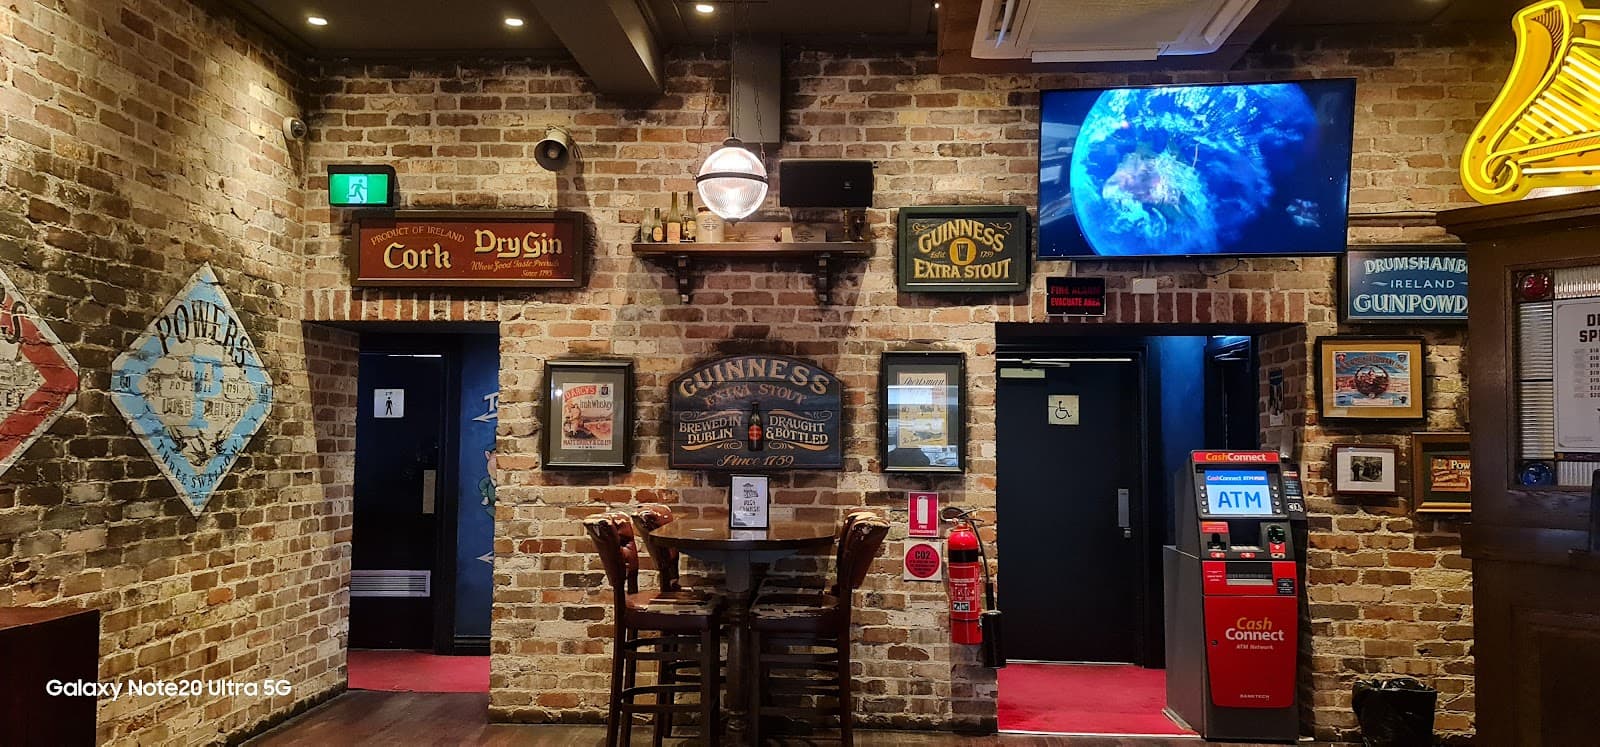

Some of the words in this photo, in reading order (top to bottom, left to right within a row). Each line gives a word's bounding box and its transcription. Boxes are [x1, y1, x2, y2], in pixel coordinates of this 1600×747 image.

[371, 227, 409, 246] PRODUCT
[412, 226, 424, 234] OF
[427, 226, 465, 243] IRELAND
[474, 229, 522, 258] Dry
[523, 232, 563, 258] Gin
[918, 219, 1005, 253] GUINNESS
[383, 242, 452, 270] Cork
[1364, 256, 1468, 275] DRUMSHANB
[913, 258, 960, 279] EXTRA
[965, 258, 1012, 279] STOUT
[1390, 279, 1455, 289] IRELAND
[1354, 294, 1468, 313] GUNPOWD
[155, 299, 252, 369] POWERS
[1579, 329, 1600, 343] SP
[679, 358, 831, 398] GUINNESS
[704, 383, 752, 407] EXTRA
[758, 383, 808, 404] STOUT
[679, 418, 727, 434] BREWED
[727, 416, 742, 427] IN
[769, 415, 825, 433] DRAUGHT
[687, 427, 733, 445] DUBLIN
[157, 439, 187, 486] THREE
[716, 454, 760, 467] Since
[762, 455, 795, 467] 1759
[1205, 452, 1266, 462] CashConnect
[1217, 491, 1262, 509] ATM
[1236, 616, 1273, 631] Cash
[1225, 627, 1285, 641] Connect
